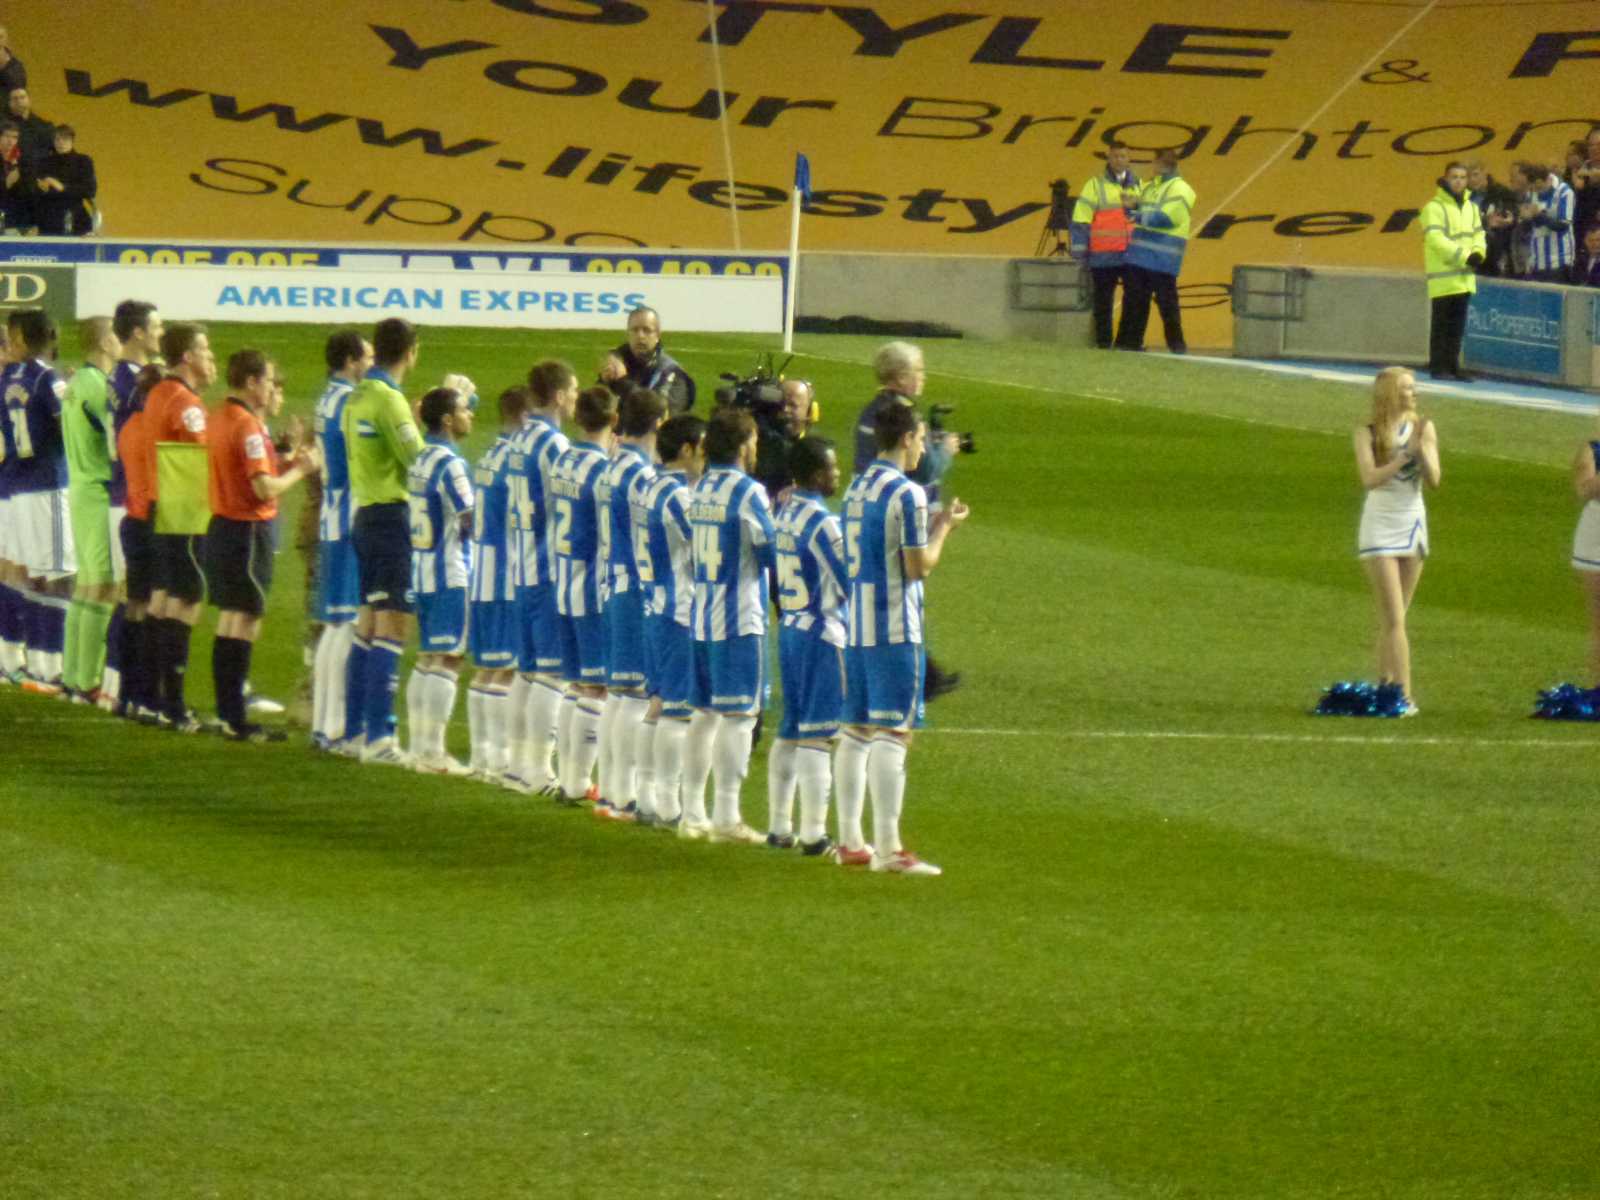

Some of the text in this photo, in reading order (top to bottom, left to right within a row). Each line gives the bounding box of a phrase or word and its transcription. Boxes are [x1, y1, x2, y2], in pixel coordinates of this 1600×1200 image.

[1360, 58, 1433, 85] &
[367, 24, 1600, 164] Your Brighton
[216, 285, 648, 315] AMERICAN EXPRESS
[555, 498, 572, 555] 2
